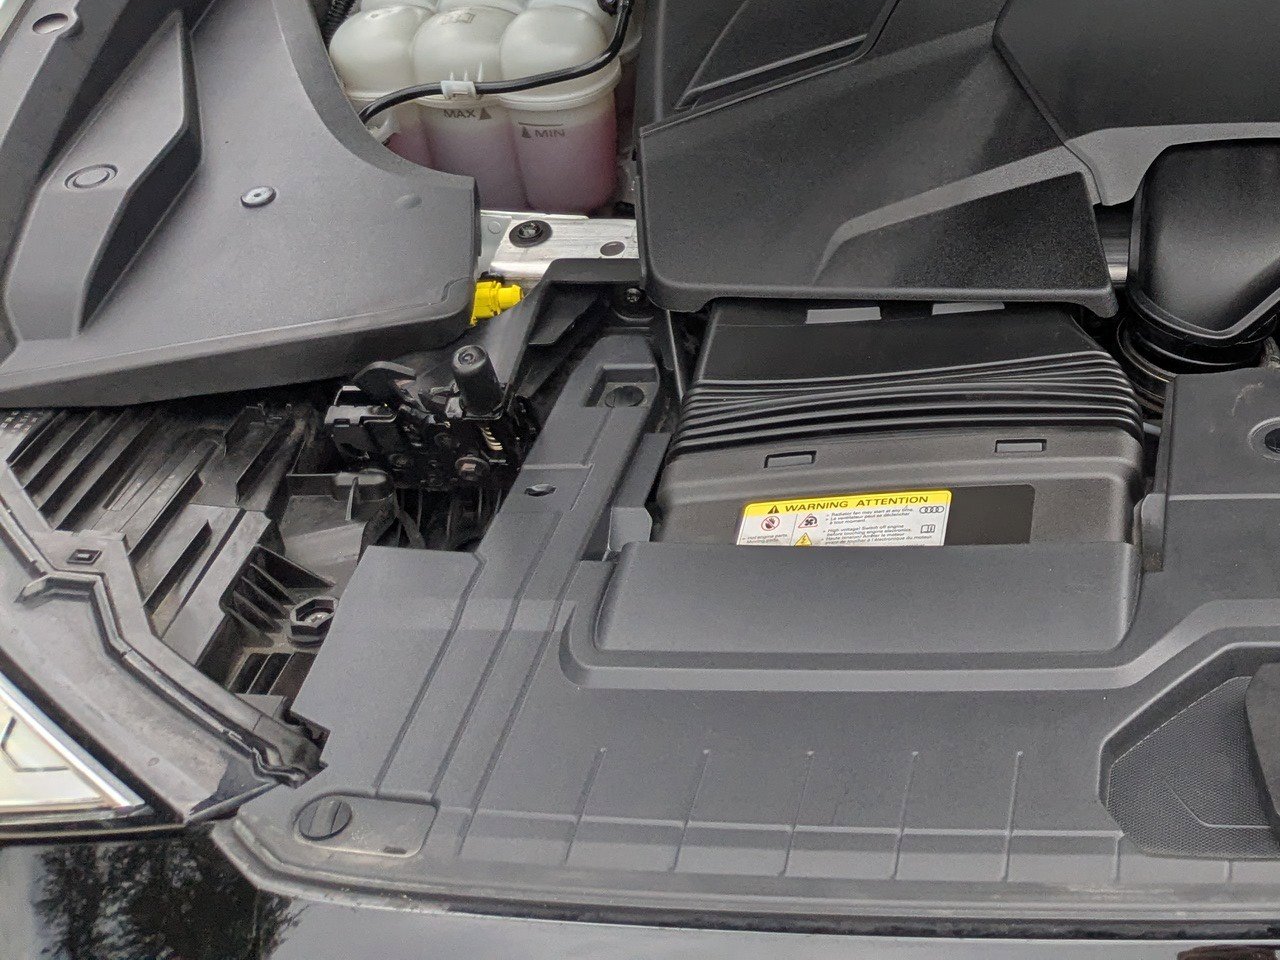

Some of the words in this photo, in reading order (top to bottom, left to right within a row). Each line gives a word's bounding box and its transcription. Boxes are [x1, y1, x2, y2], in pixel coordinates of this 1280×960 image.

[443, 109, 475, 118] MAX
[535, 129, 565, 138] MIN
[785, 501, 848, 512] WARNING
[856, 496, 929, 507] ATTENTION
